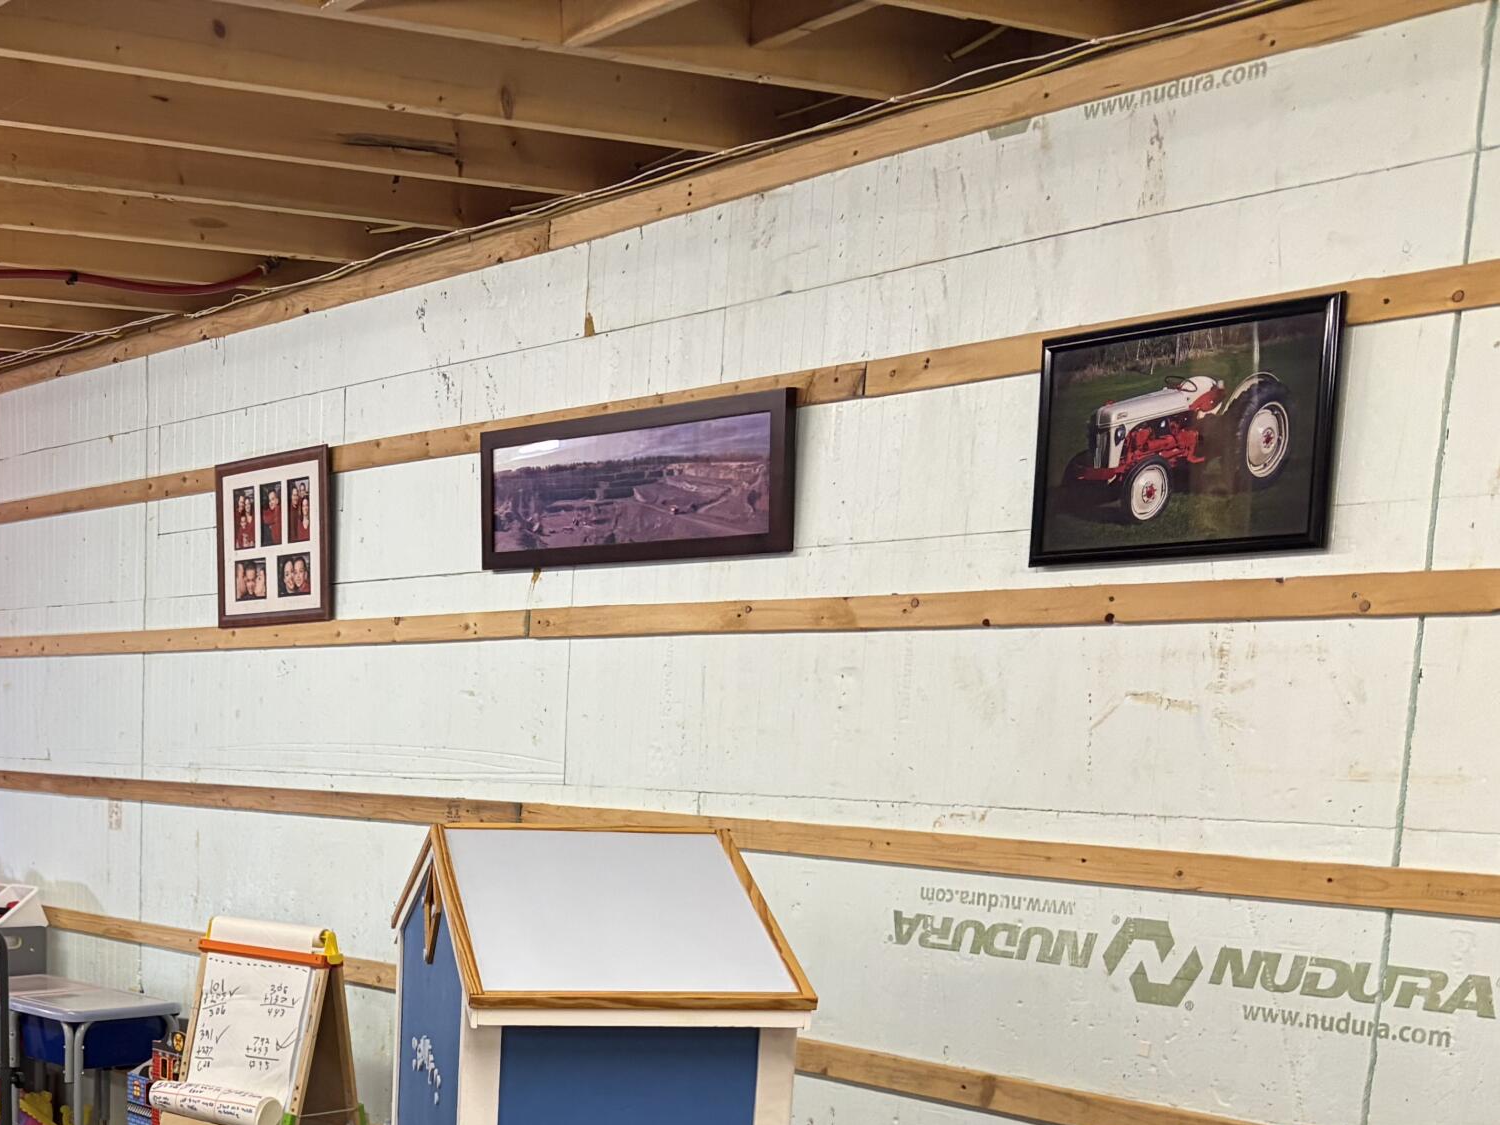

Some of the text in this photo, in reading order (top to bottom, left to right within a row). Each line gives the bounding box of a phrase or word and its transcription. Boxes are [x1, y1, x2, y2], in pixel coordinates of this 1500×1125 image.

[1084, 61, 1267, 120] www.nudura.com
[920, 887, 1076, 915] www.nudura.com
[893, 910, 1098, 968] NUDURA
[1209, 946, 1496, 1019] NUDURA
[1243, 1004, 1451, 1048] www.nudura.com
